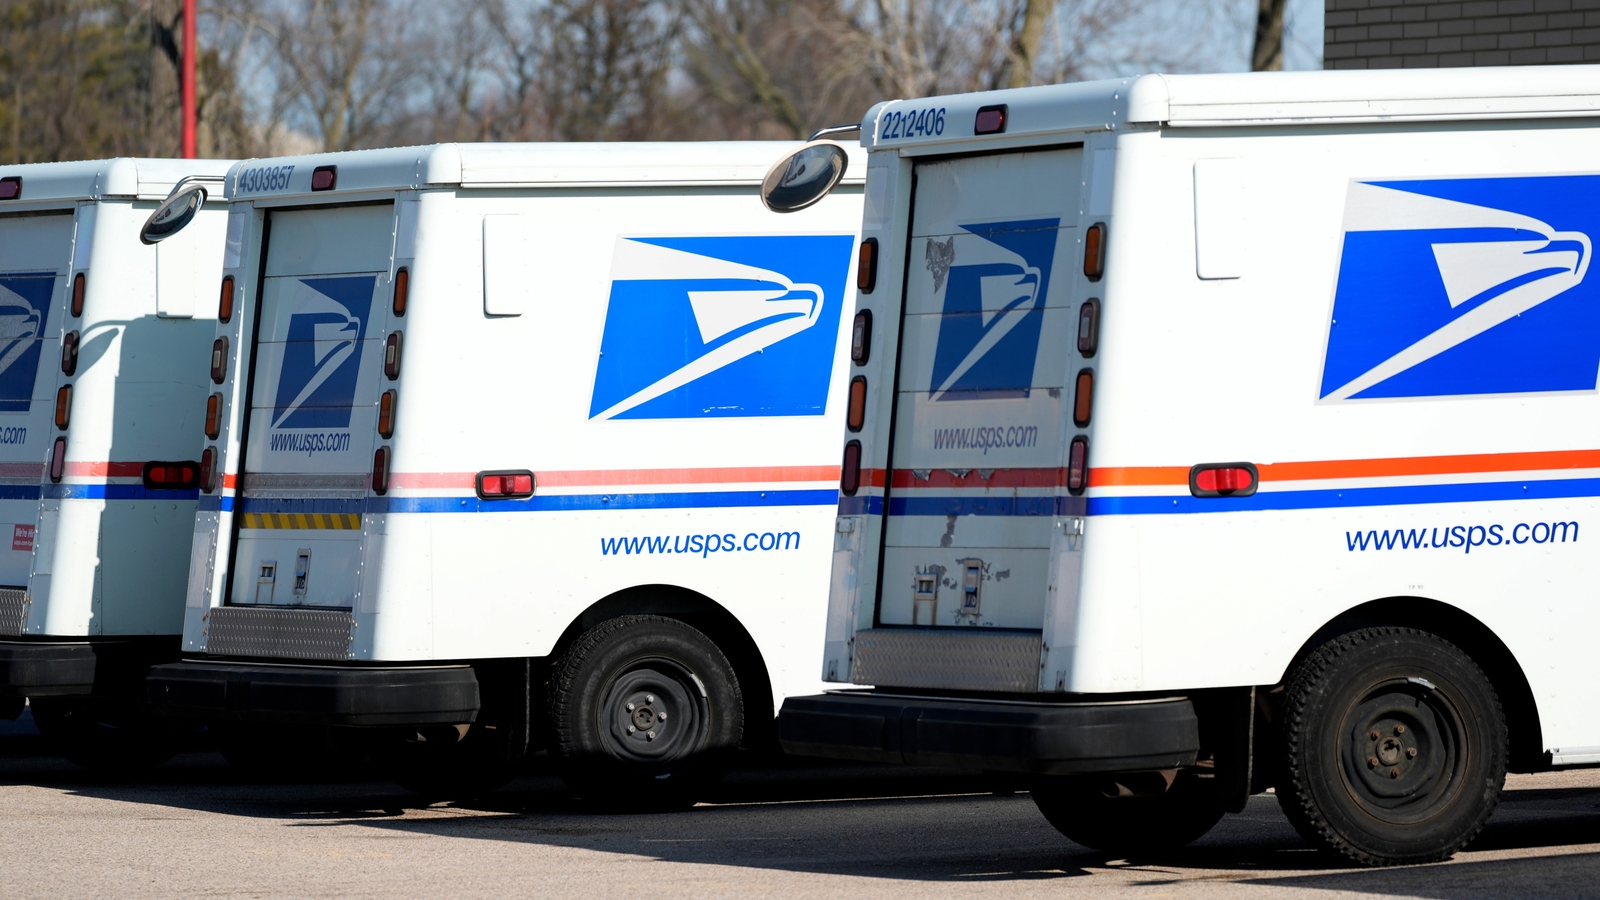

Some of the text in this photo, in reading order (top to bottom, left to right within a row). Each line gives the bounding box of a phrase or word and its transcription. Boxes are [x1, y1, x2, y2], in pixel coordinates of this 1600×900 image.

[881, 107, 946, 140] 2212406
[239, 165, 296, 193] 4303857
[270, 432, 351, 458] www.usps.com
[934, 425, 1038, 456] www.usps.com
[600, 530, 801, 559] www.usps.com
[1345, 520, 1579, 554] www.usps.com
